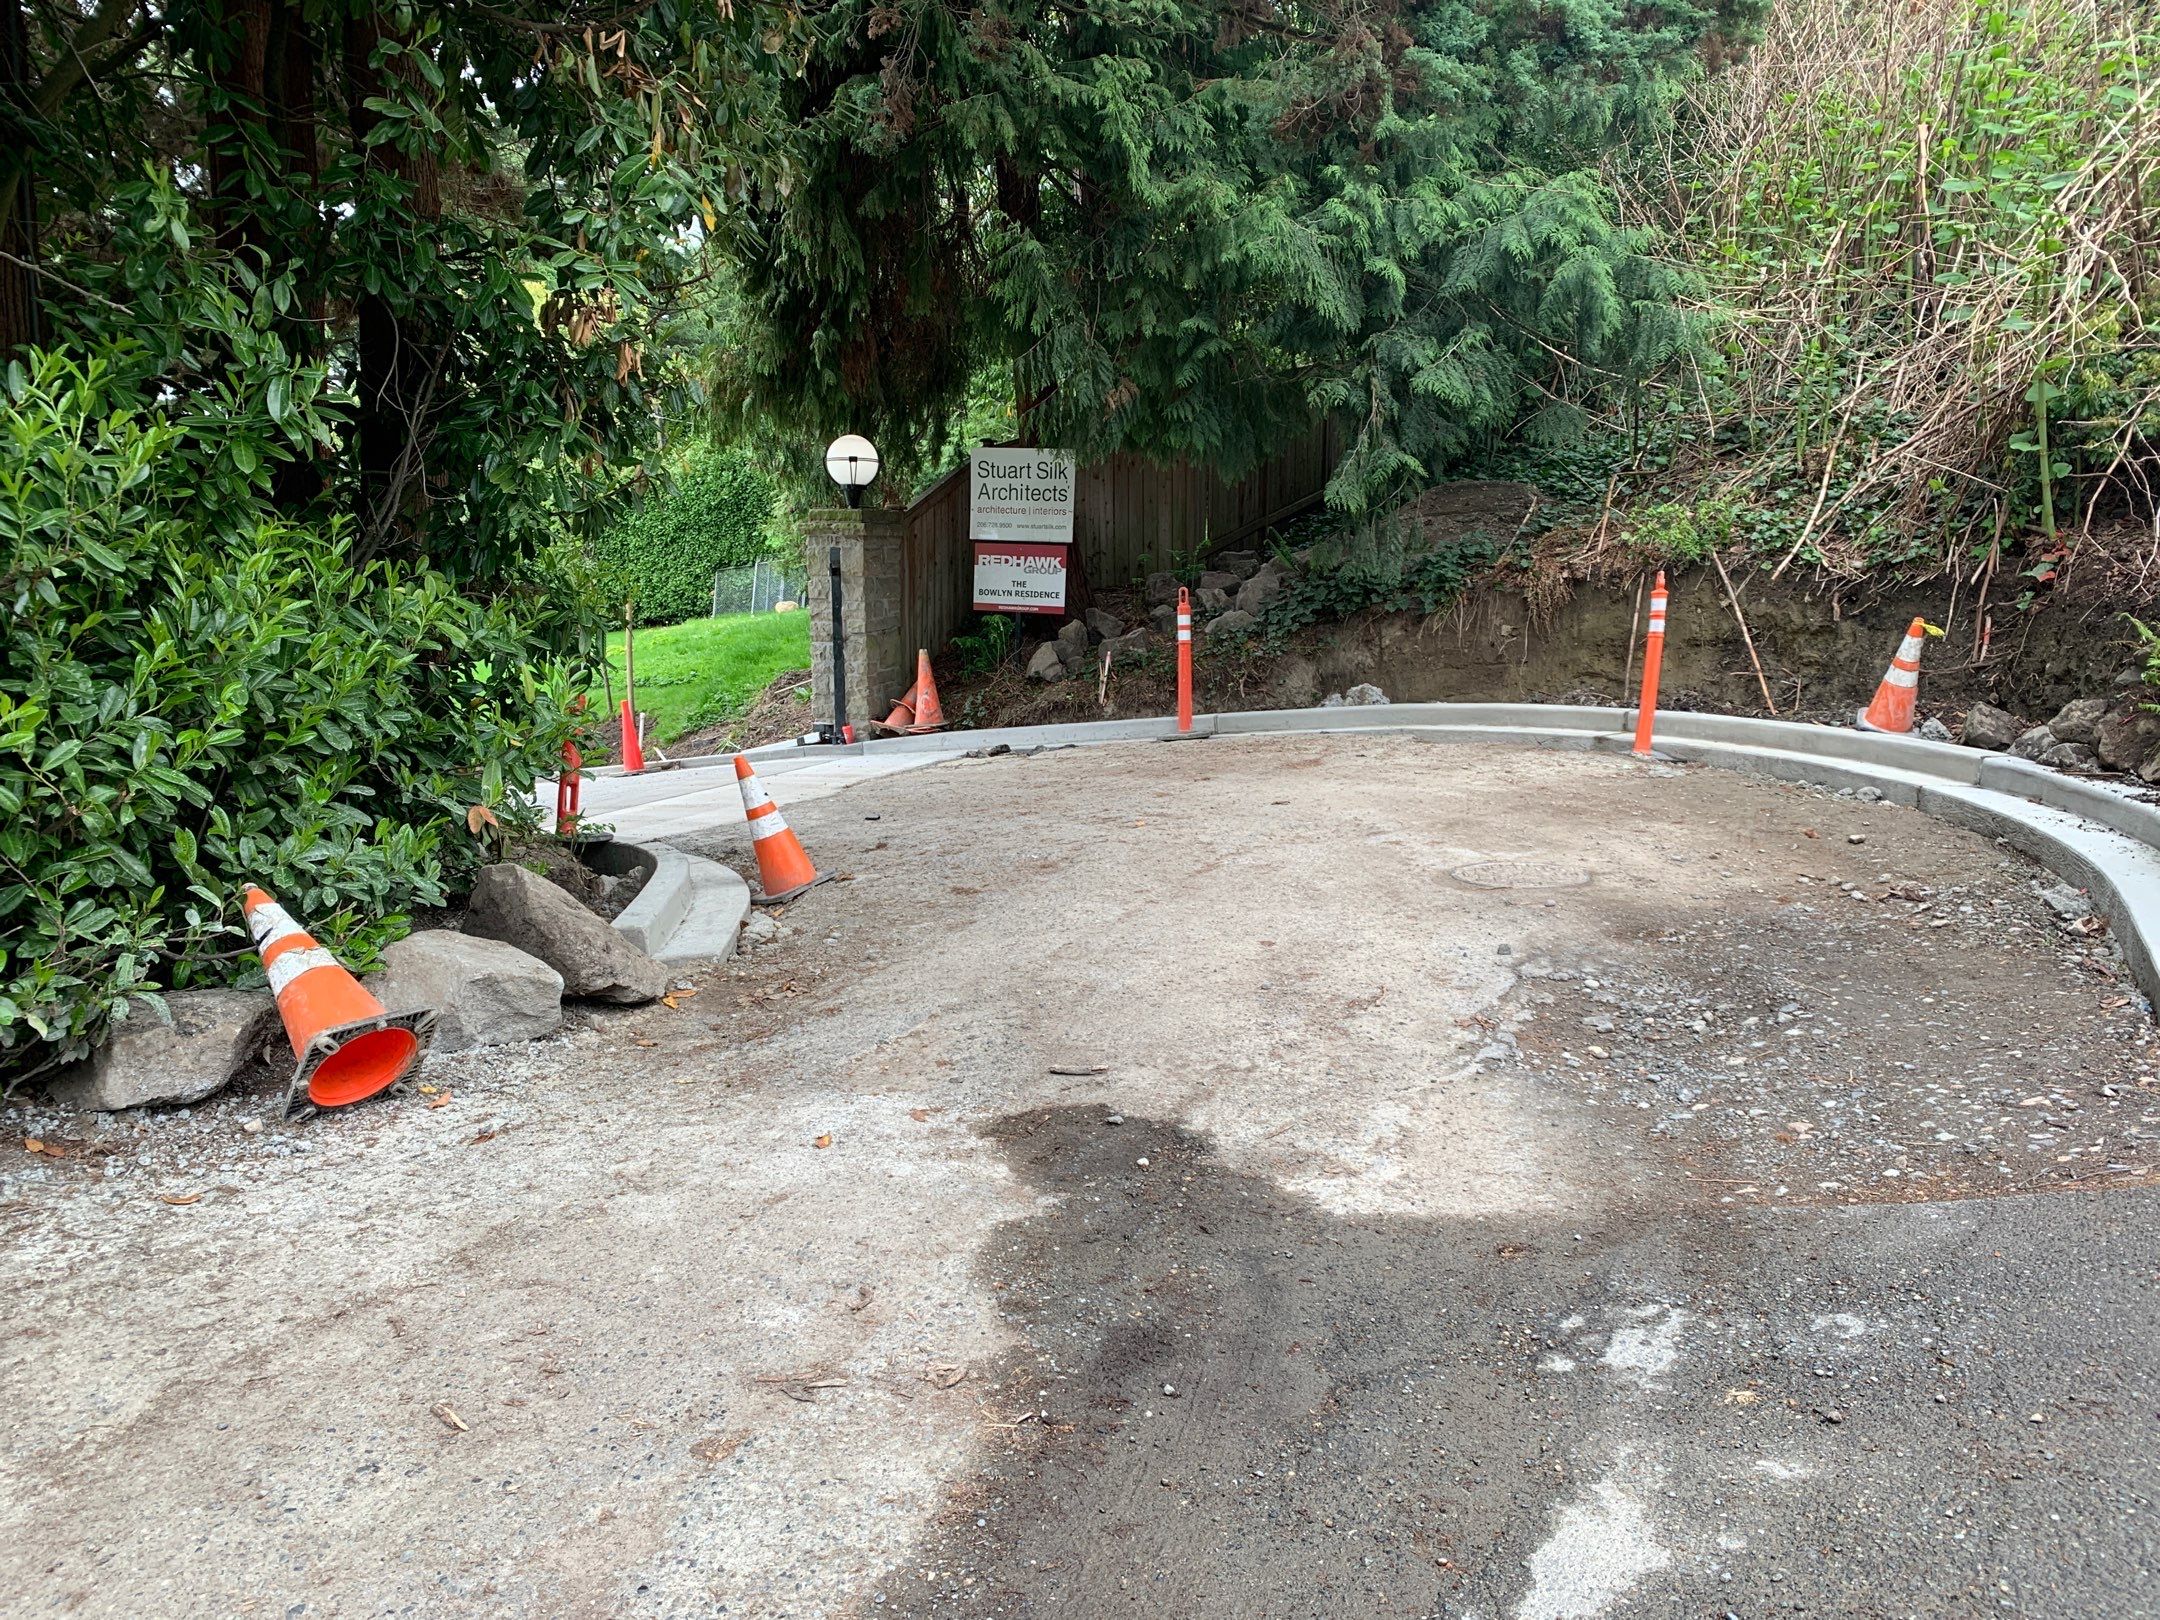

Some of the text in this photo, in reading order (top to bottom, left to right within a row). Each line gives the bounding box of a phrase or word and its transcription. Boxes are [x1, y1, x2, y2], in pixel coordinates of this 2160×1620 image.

[977, 460, 1068, 480] Stuart Silk
[977, 482, 1068, 502] Architects
[977, 505, 1027, 515] architecture
[1032, 507, 1067, 516] interiors
[978, 554, 1062, 568] REDHAWK
[1023, 567, 1062, 575] GROUP
[1011, 580, 1027, 588] THE
[978, 588, 1060, 599] BOWLYN RESIDENCE
